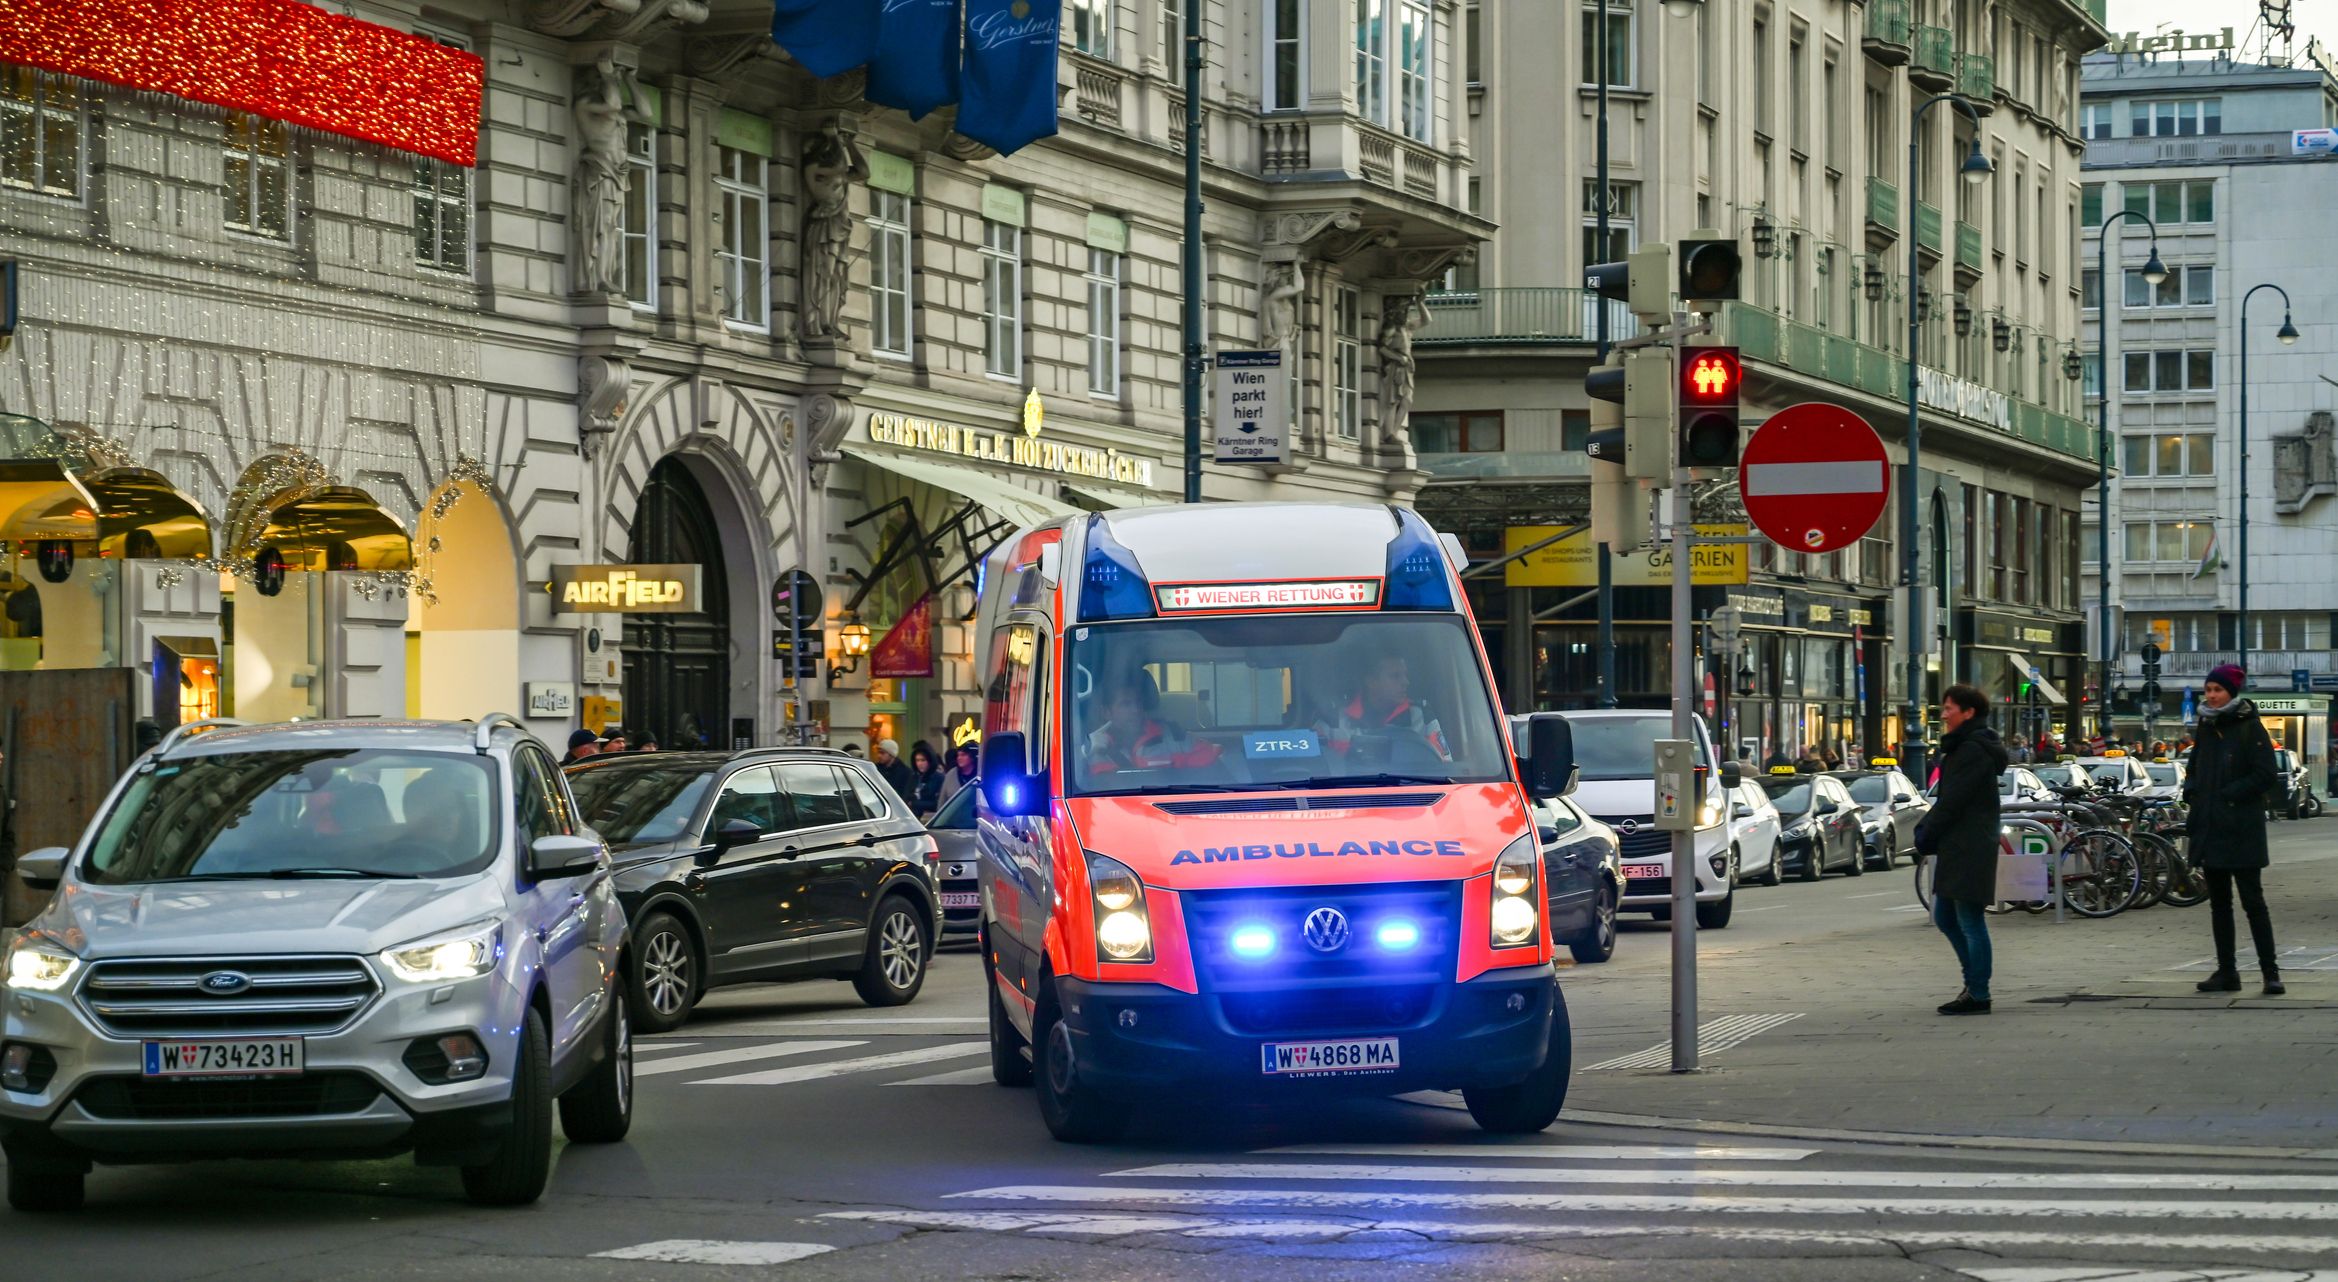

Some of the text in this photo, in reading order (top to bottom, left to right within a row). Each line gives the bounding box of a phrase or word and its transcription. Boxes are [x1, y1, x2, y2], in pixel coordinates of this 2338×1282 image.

[2109, 26, 2236, 53] Meinl
[1589, 277, 1600, 288] 21
[1232, 372, 1265, 384] Wien
[1232, 389, 1266, 404] parkt
[1234, 406, 1263, 418] hier!
[870, 412, 958, 455] GERSTNER
[1218, 436, 1278, 446] Kärntner Ring
[1232, 446, 1264, 456] Garage
[1648, 551, 1735, 568] GARIEN
[1197, 588, 1344, 604] WIENER RETTUNG
[2255, 701, 2297, 709] AGUETTE
[1255, 739, 1310, 752] ZTR-3
[1169, 840, 1466, 866] AMBULANCE
[946, 894, 968, 904] 7337
[210, 976, 238, 987] Ford
[163, 1046, 180, 1070] W
[1278, 1048, 1292, 1068] W
[1310, 1045, 1361, 1066] 4868
[1366, 1043, 1394, 1064] MA
